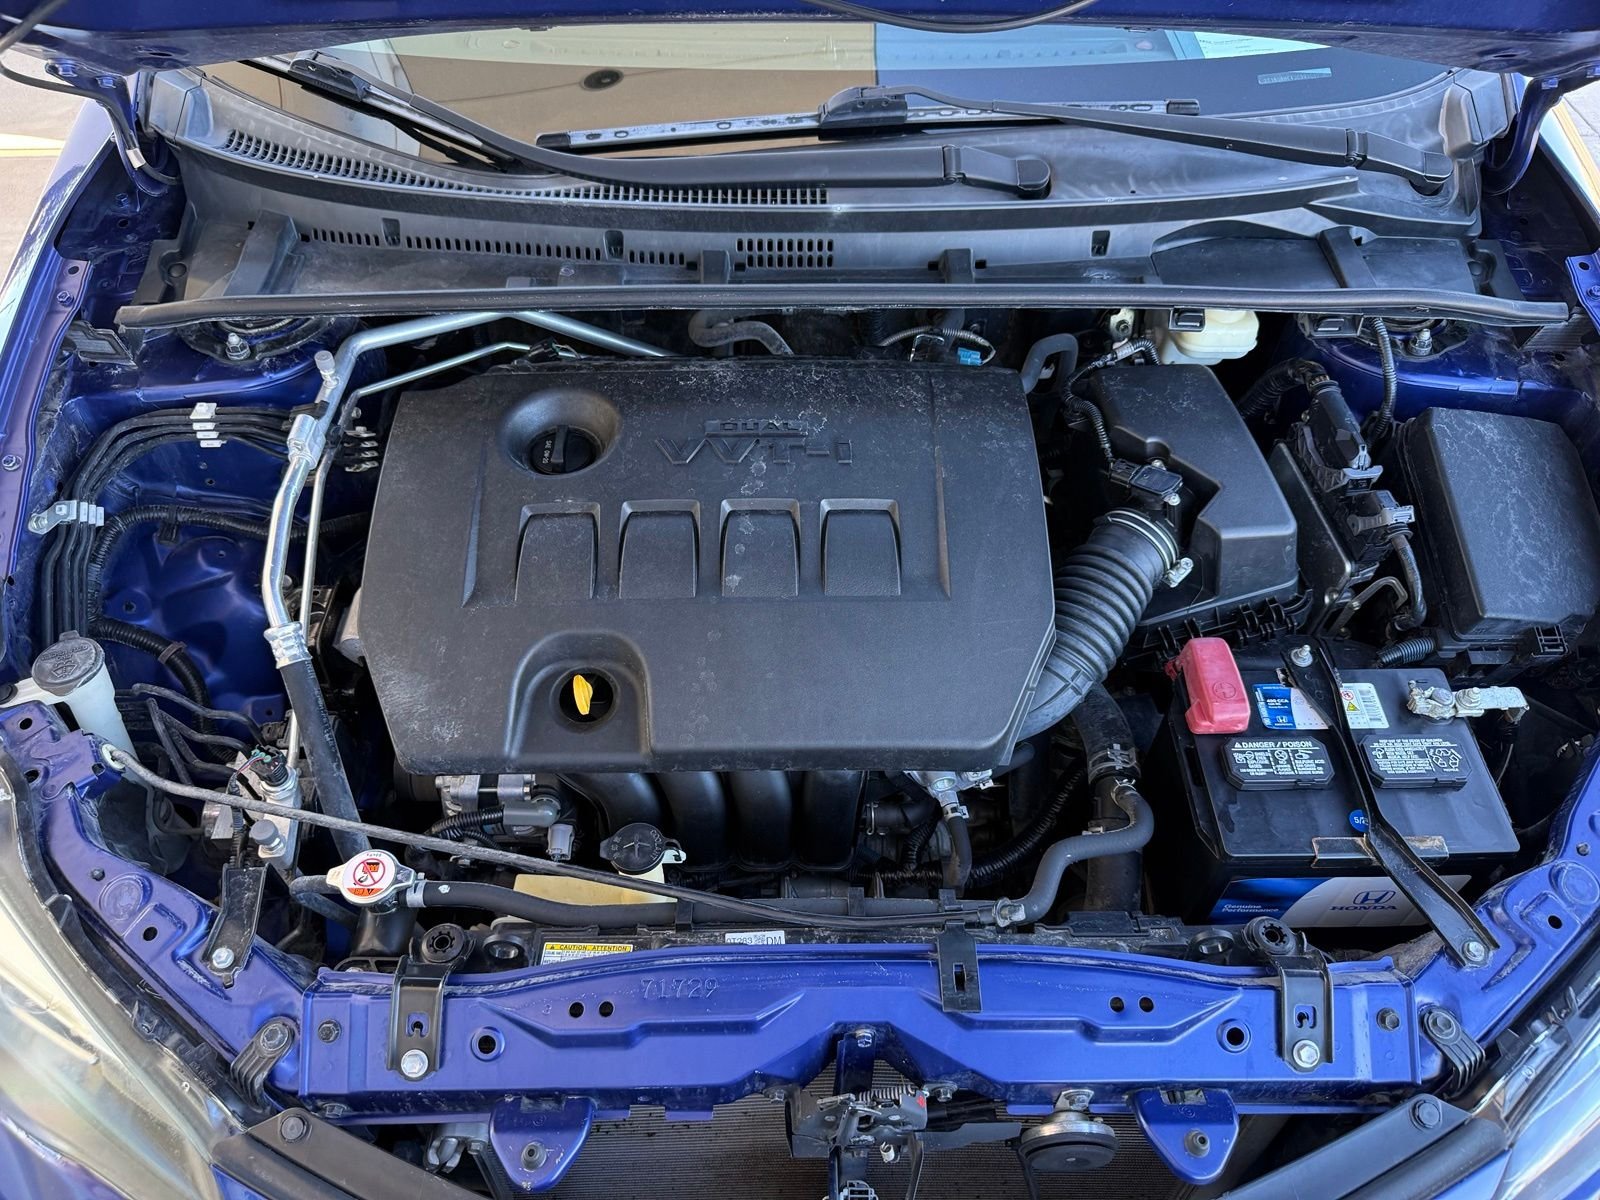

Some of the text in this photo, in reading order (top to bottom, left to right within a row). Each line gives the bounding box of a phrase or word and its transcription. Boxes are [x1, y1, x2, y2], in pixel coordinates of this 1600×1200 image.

[719, 421, 800, 431] DUAL
[1241, 741, 1275, 749] DANGER
[1282, 740, 1313, 748] POISON
[591, 944, 628, 952] ATTENTION
[640, 977, 719, 999] 71729
